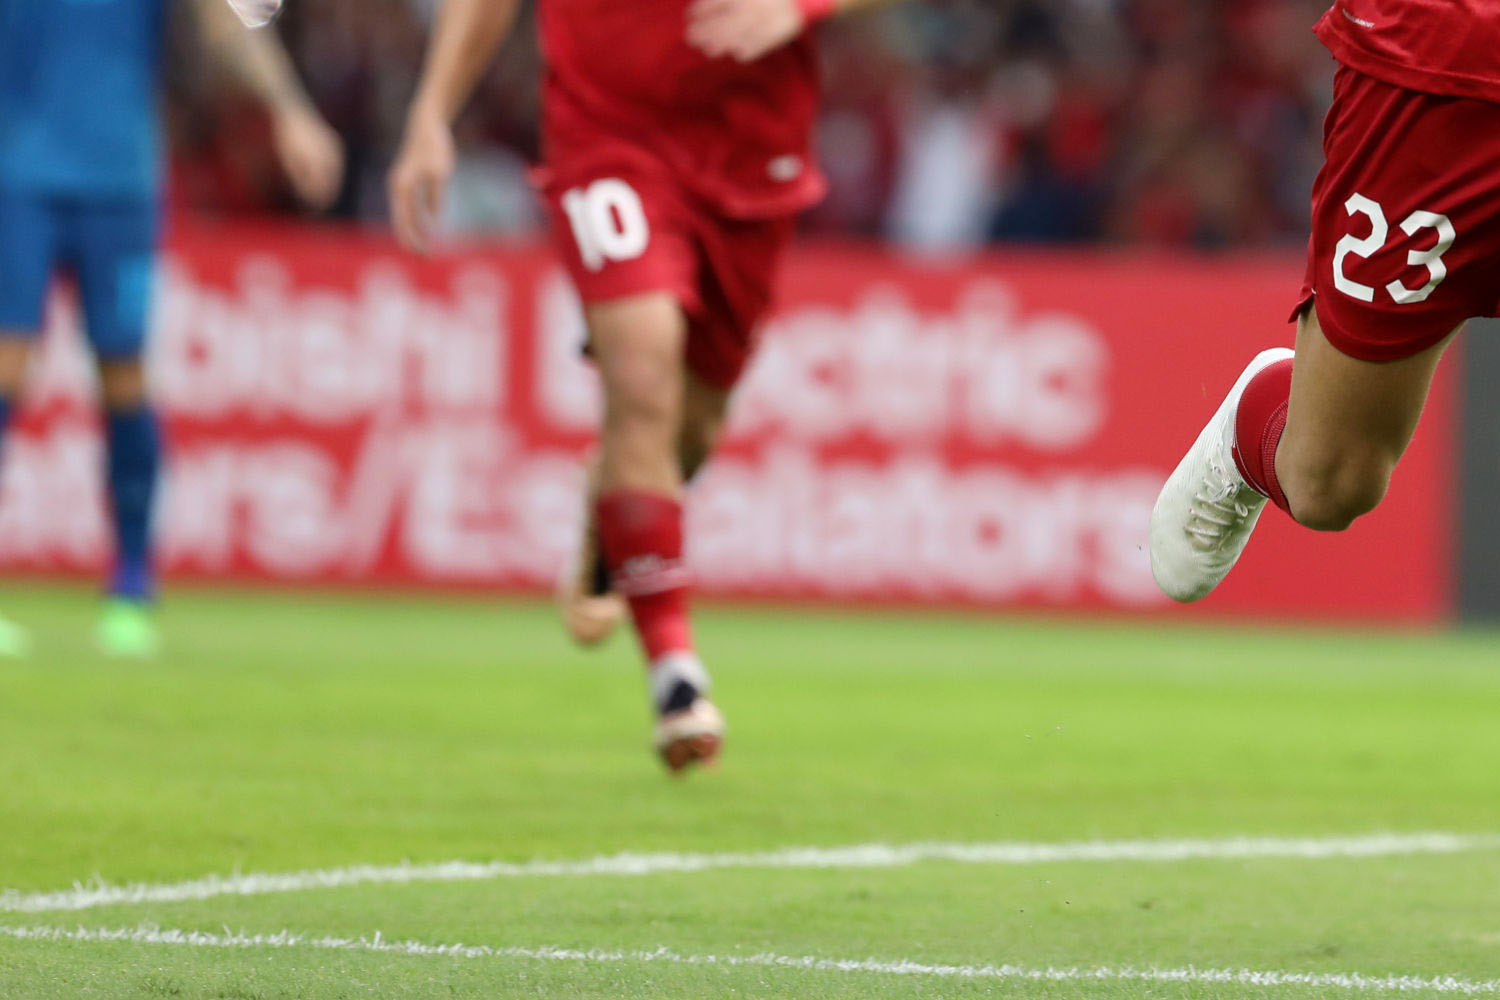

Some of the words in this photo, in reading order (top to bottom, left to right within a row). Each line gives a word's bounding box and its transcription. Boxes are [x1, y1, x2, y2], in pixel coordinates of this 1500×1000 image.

[562, 178, 649, 274] 10
[1332, 191, 1456, 305] 23
[533, 262, 1108, 450] Ectric
